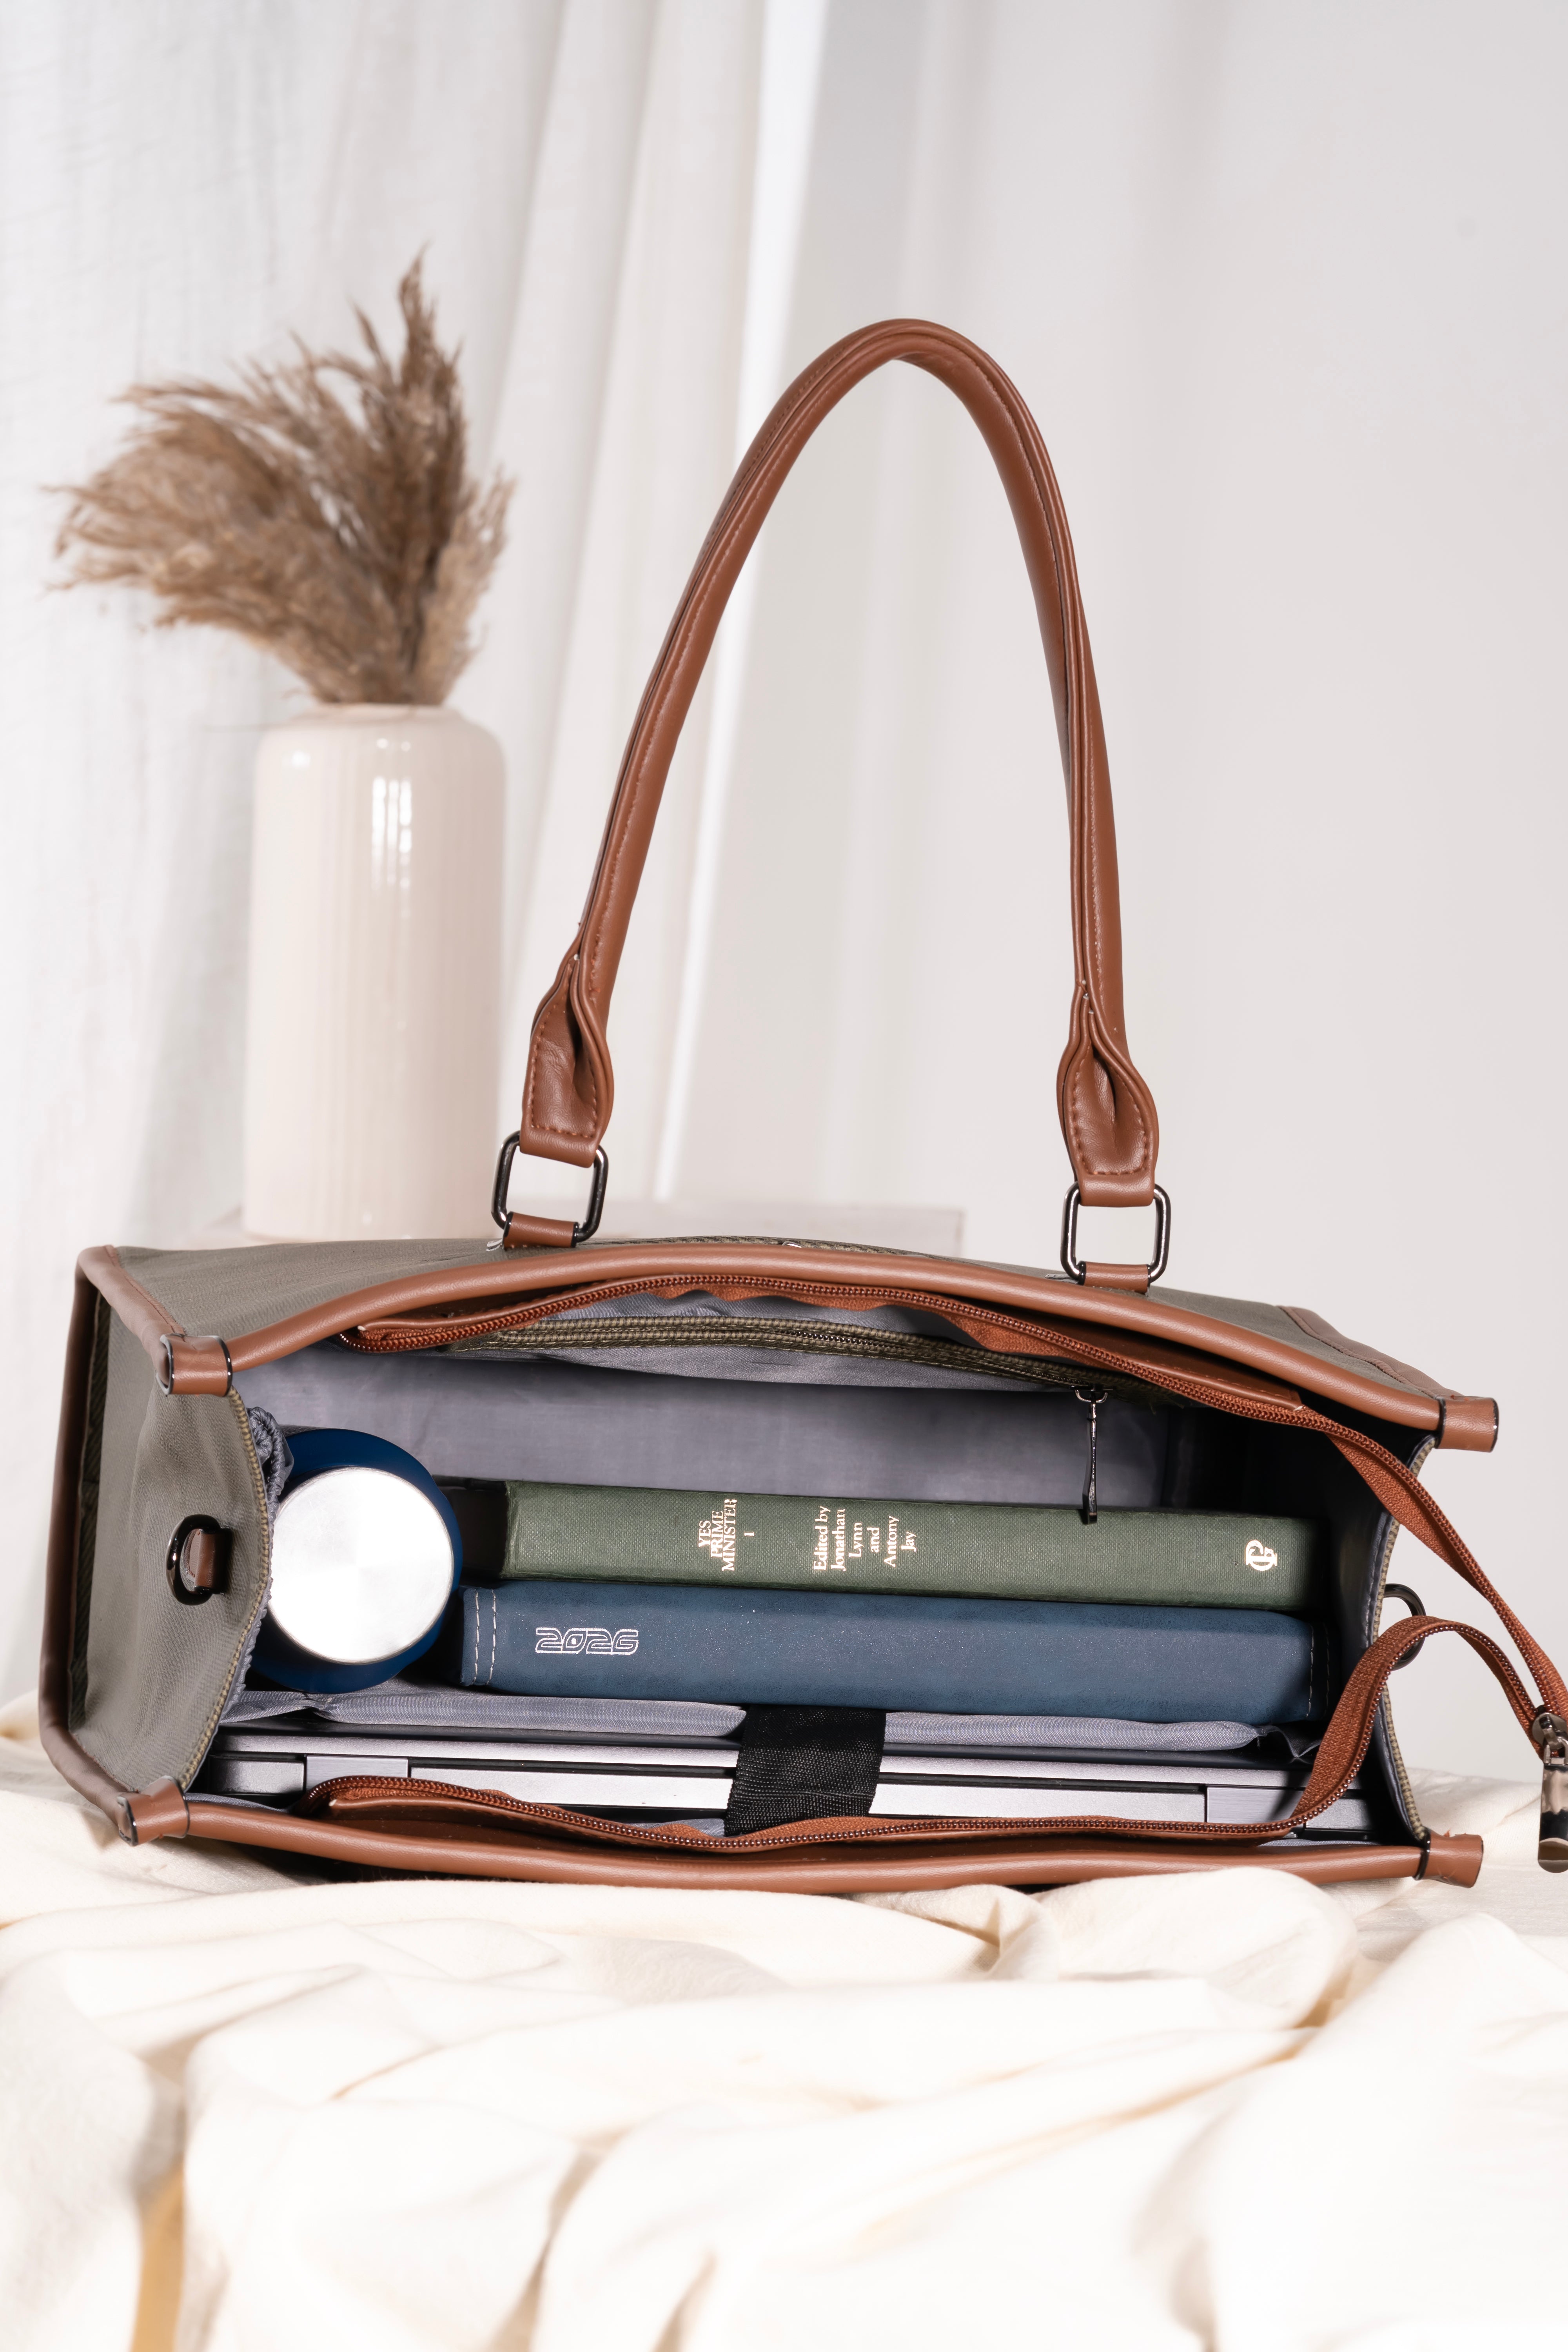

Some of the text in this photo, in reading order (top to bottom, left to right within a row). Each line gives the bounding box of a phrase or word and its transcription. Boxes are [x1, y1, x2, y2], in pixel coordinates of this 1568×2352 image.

[698, 1521, 711, 1548] YES
[710, 1510, 724, 1558] PRIME
[722, 1499, 737, 1571] MINISTER
[813, 1506, 831, 1570] Edited by
[831, 1509, 846, 1571] Jonathan
[848, 1522, 864, 1558] Lynn
[867, 1527, 880, 1553] and
[884, 1515, 900, 1568] Antony
[901, 1531, 917, 1552] Jay
[535, 1627, 639, 1655] 2026
